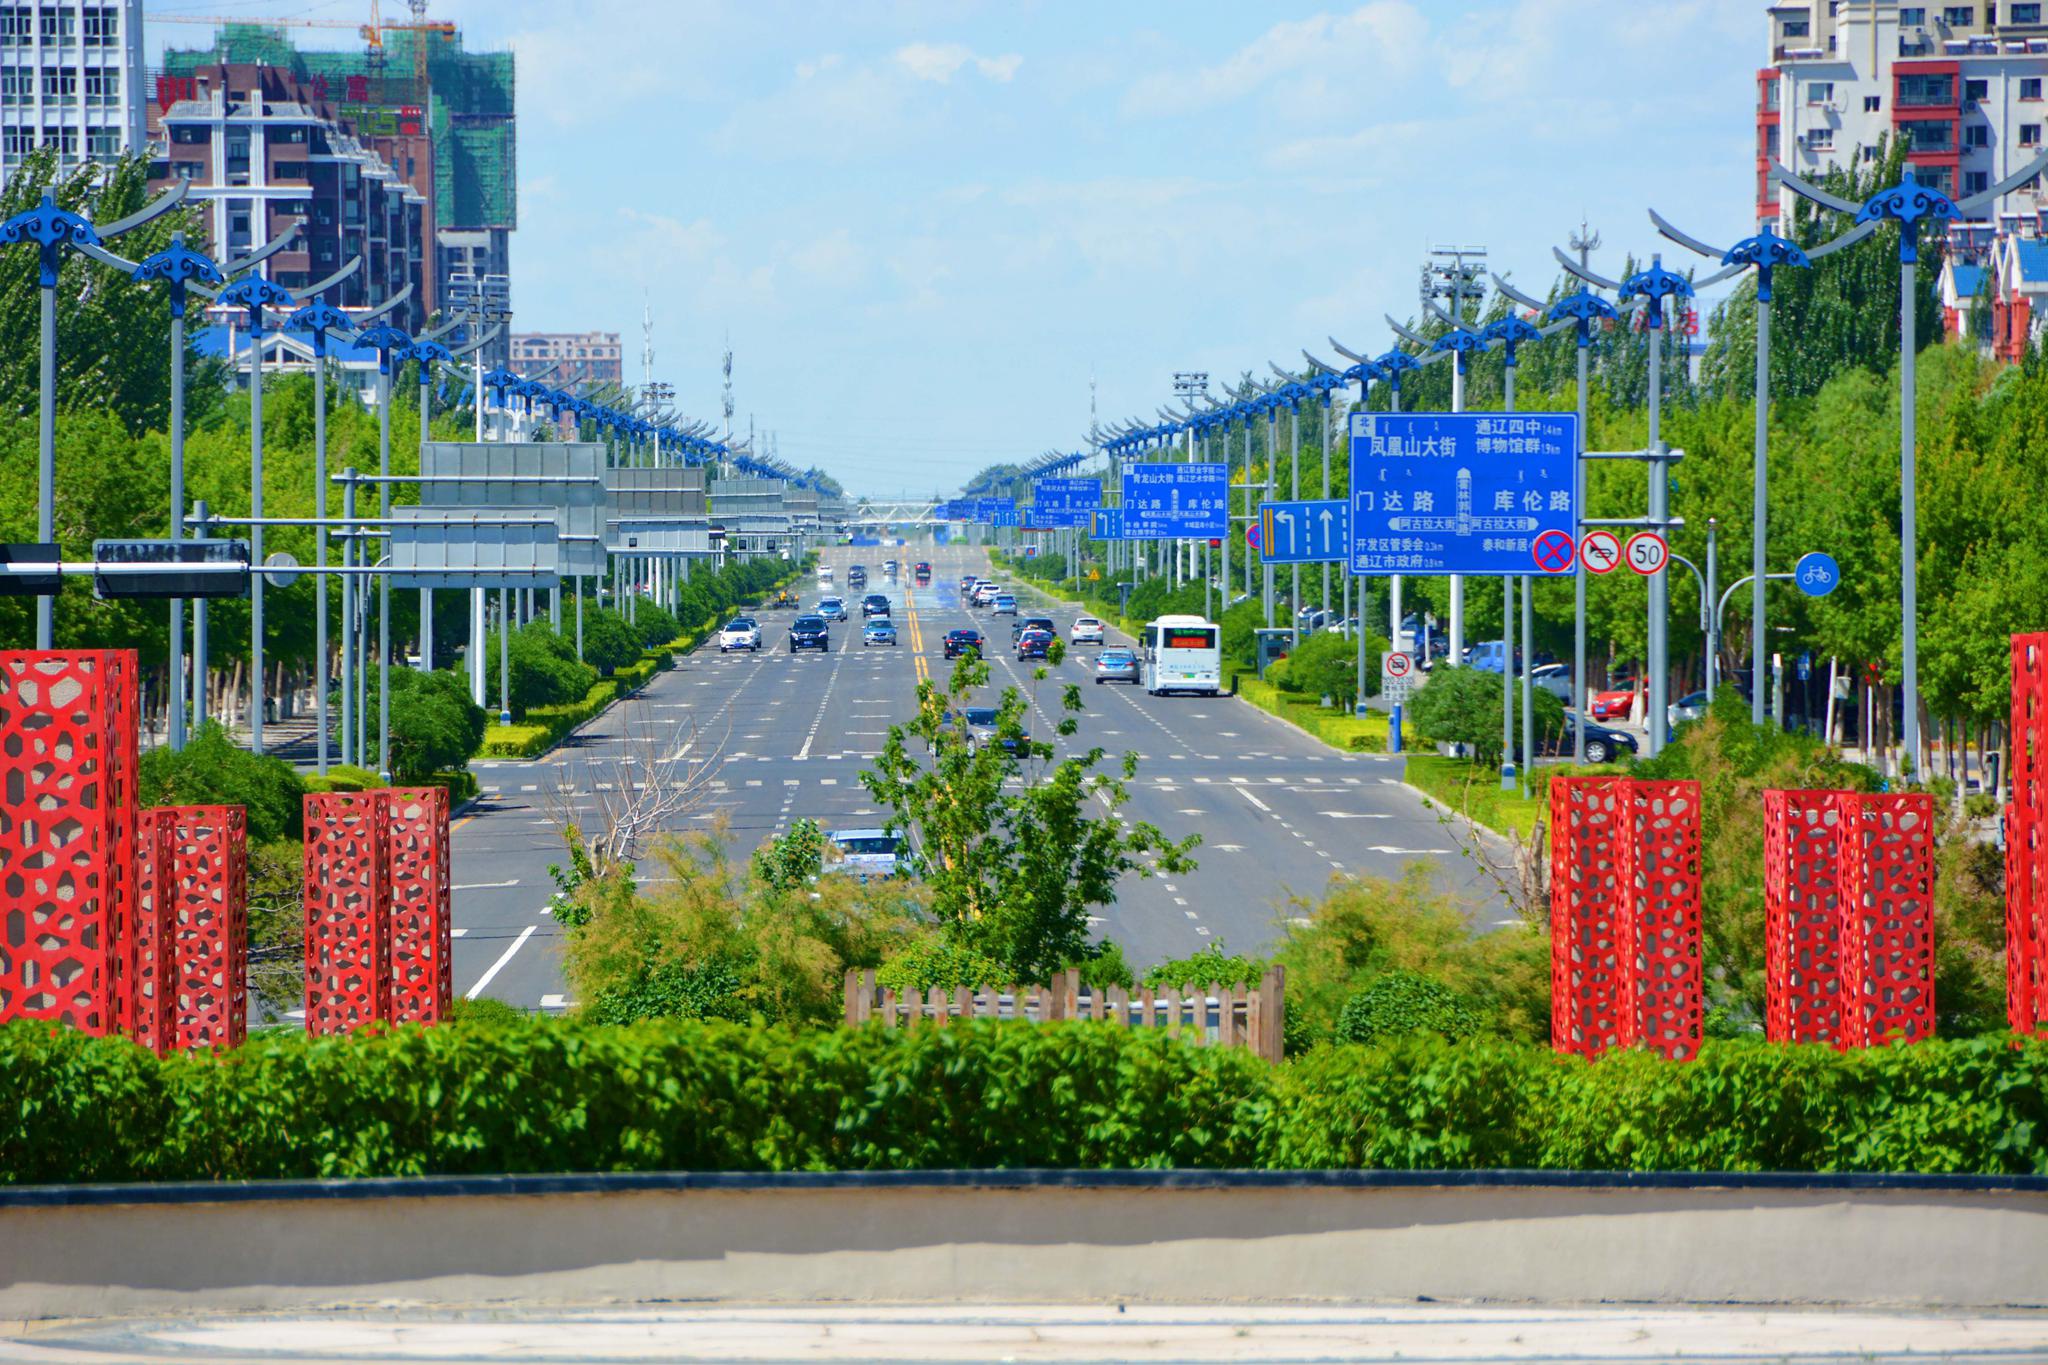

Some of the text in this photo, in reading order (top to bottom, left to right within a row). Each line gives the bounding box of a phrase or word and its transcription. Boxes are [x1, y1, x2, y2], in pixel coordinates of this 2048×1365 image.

[1359, 416, 1370, 428] 北
[1475, 418, 1541, 435] 通辽四中
[1369, 435, 1457, 458] 凤凰山大街
[1475, 437, 1541, 454] 博物馆群
[1133, 473, 1174, 484] 青龙山大街
[1124, 498, 1162, 510] 门达路
[1355, 489, 1435, 513] 门达路
[1494, 489, 1571, 513] 库伦路
[1400, 517, 1456, 530] 阿古拉大街
[1471, 517, 1528, 530] 阿古拉大街
[1355, 537, 1424, 552] 开发区管委会
[1355, 554, 1424, 569] 通辽市政府
[1635, 544, 1661, 566] 50
